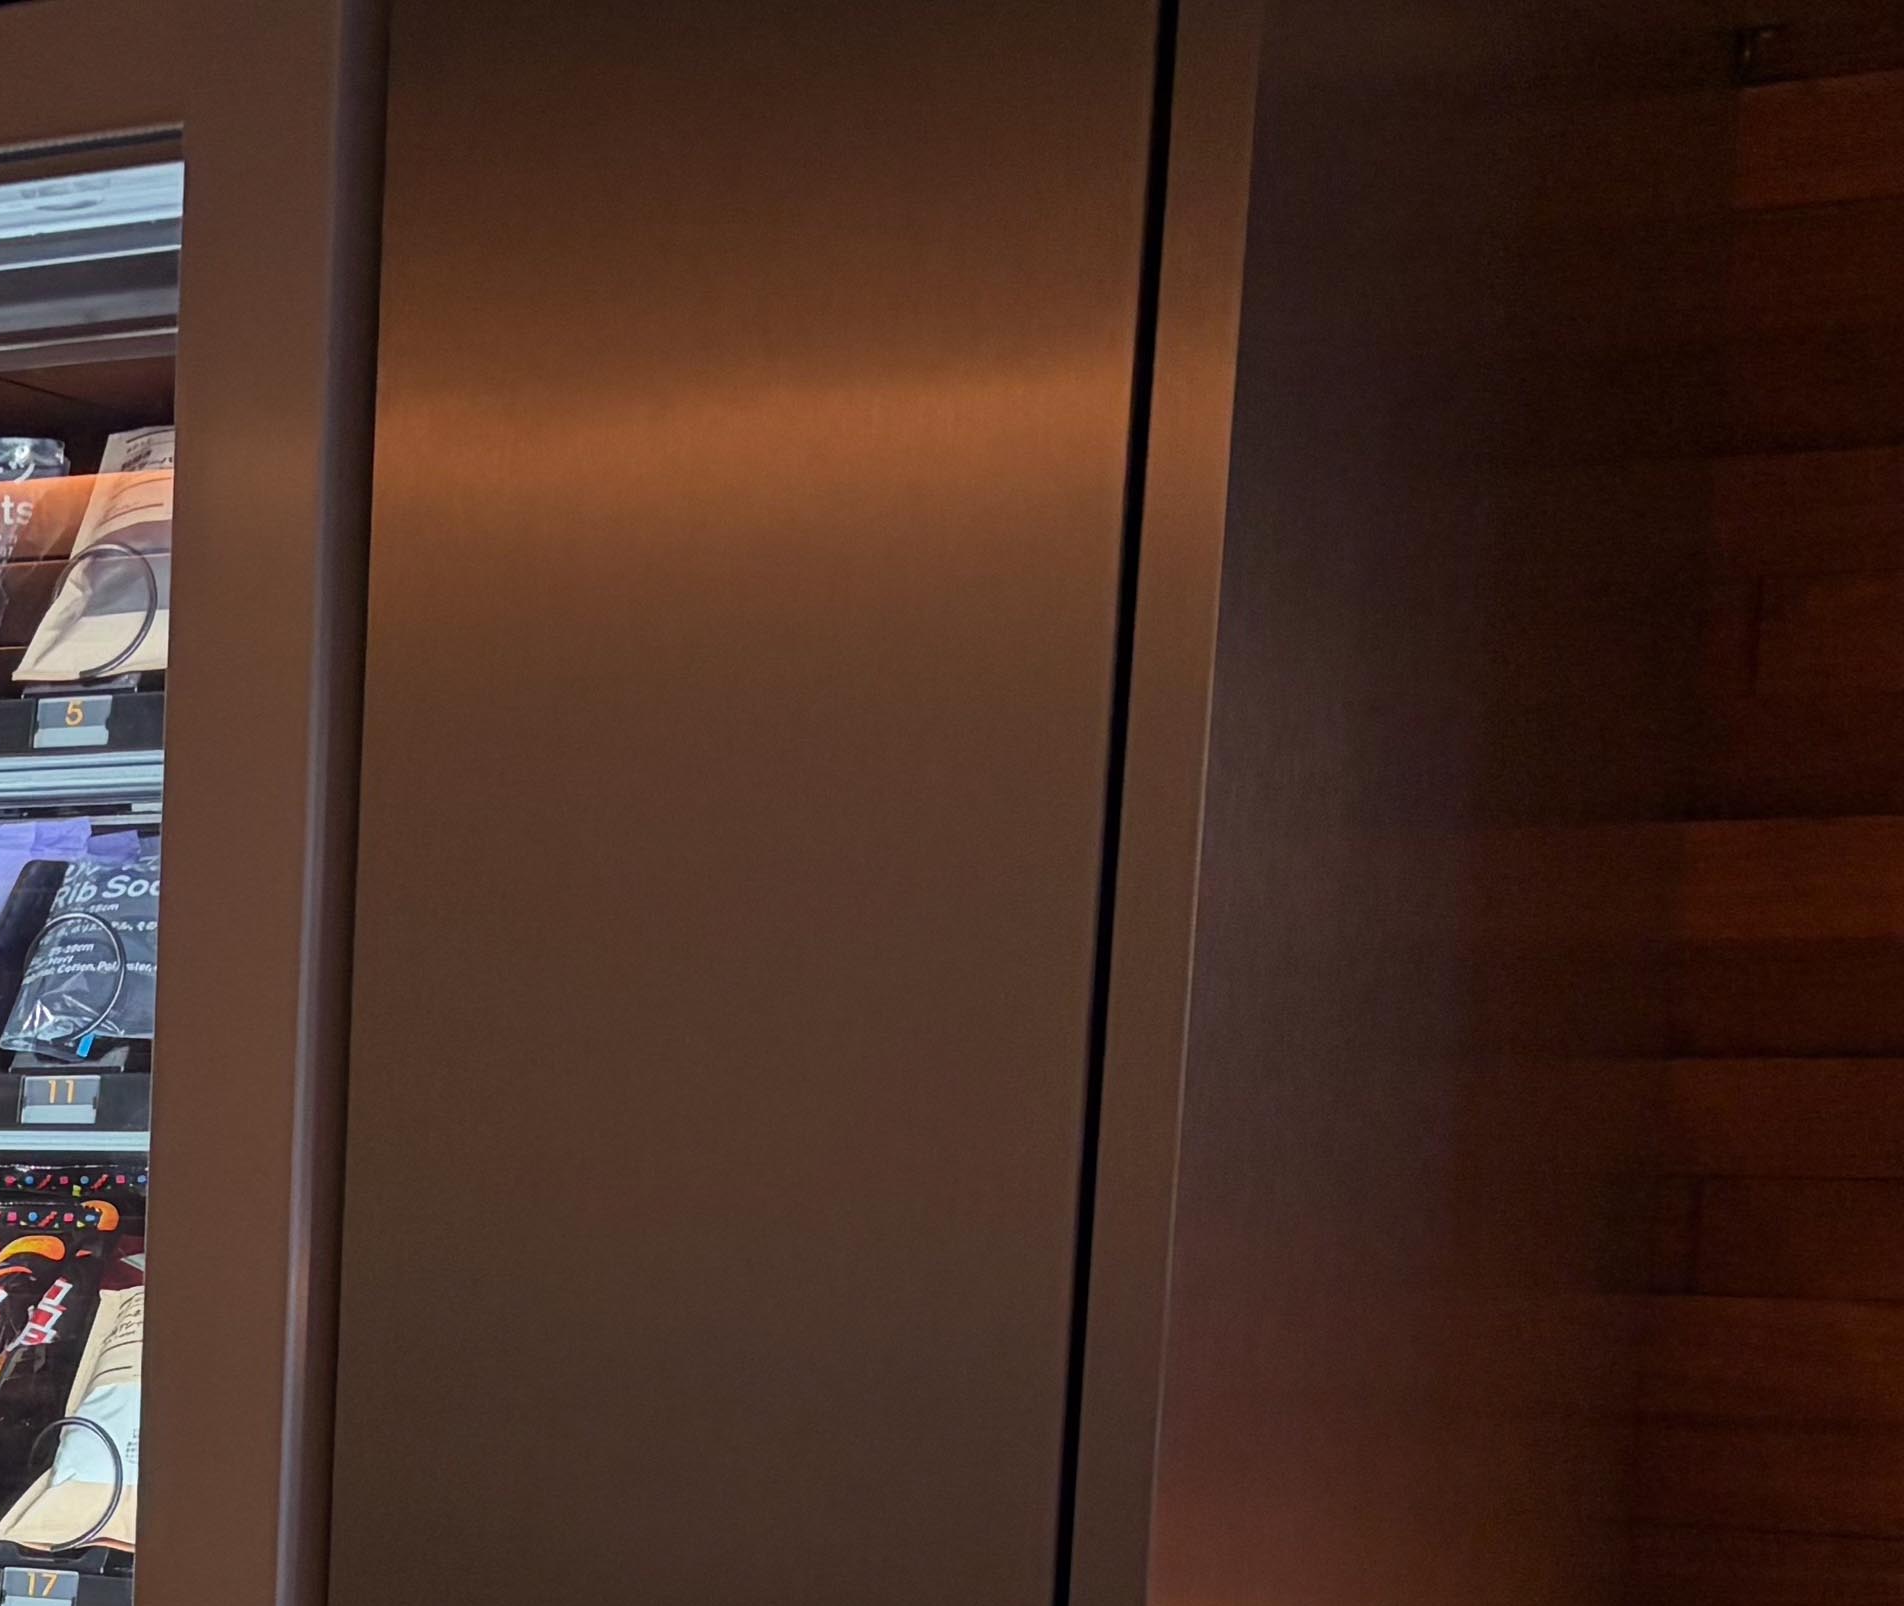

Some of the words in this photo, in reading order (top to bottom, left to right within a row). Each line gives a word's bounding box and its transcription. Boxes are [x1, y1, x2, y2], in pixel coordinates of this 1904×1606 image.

[64, 702, 84, 727] 5
[48, 1079, 77, 1104] 11
[26, 1572, 58, 1598] 17
